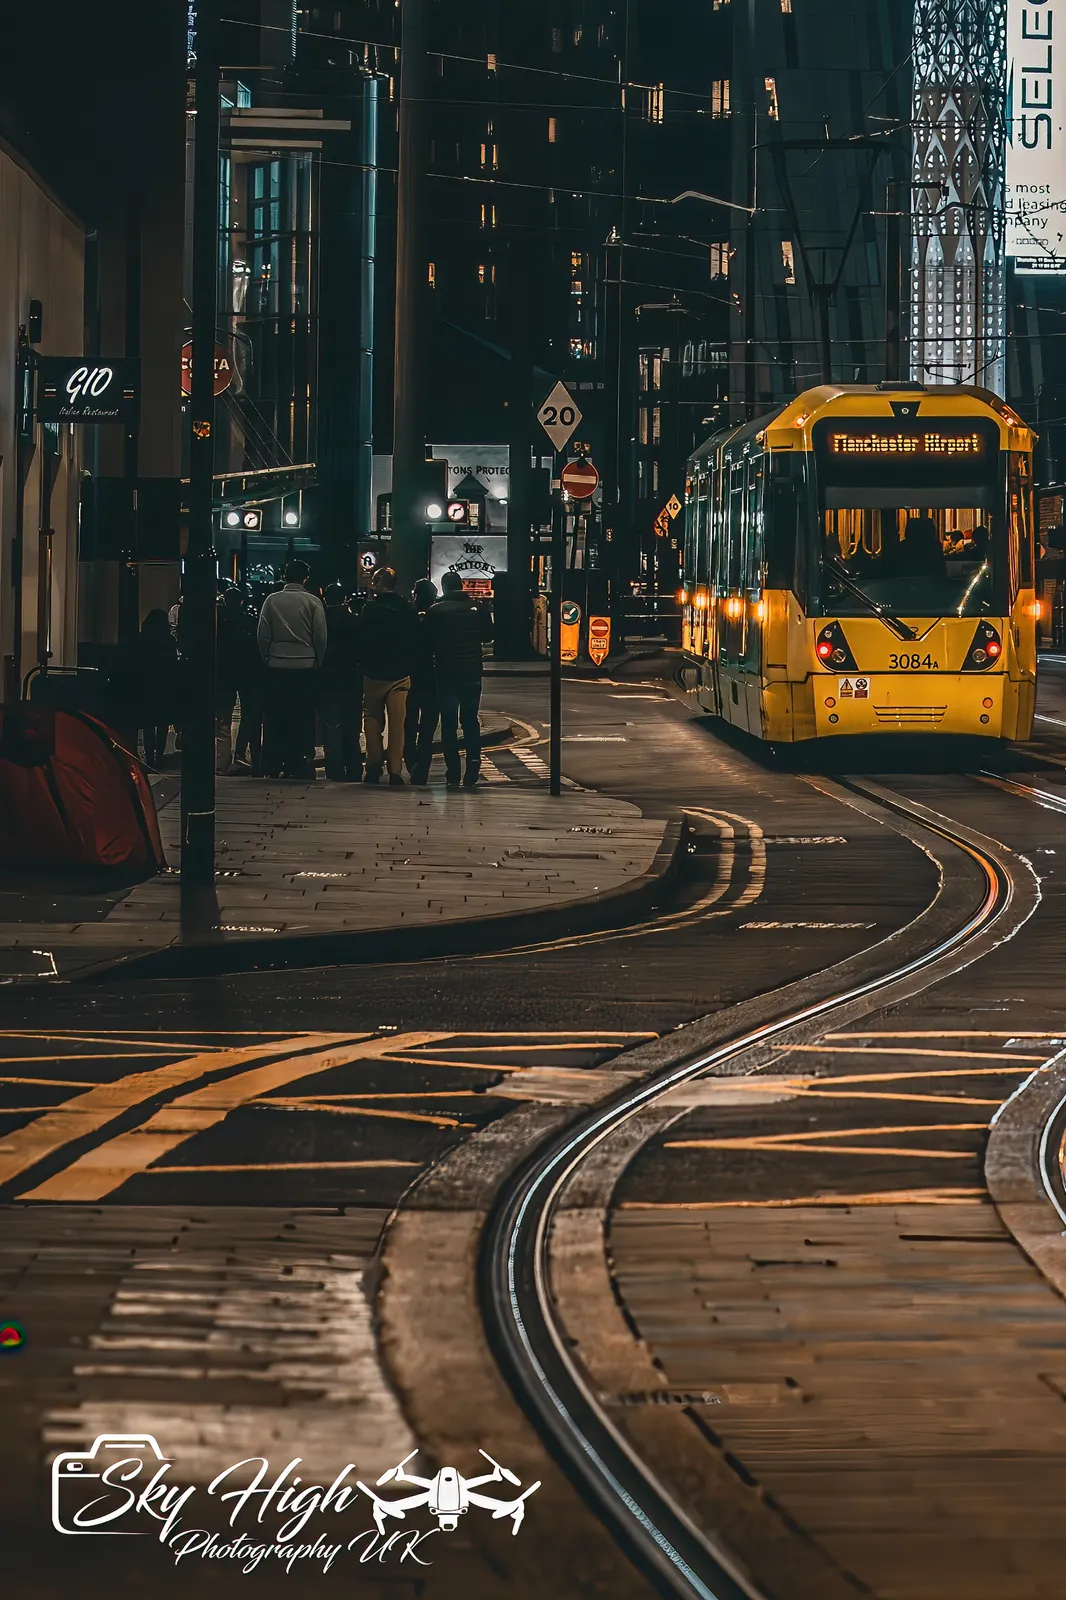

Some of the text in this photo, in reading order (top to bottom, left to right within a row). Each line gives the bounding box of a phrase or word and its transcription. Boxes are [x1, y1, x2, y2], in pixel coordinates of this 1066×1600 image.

[1016, 184, 1051, 194] most
[66, 366, 113, 403] GIO
[82, 406, 119, 416] Restaurant
[543, 406, 576, 426] 20
[834, 433, 980, 455] Manchester Airport
[476, 465, 509, 475] PROTEC
[448, 560, 496, 573] BRITONS
